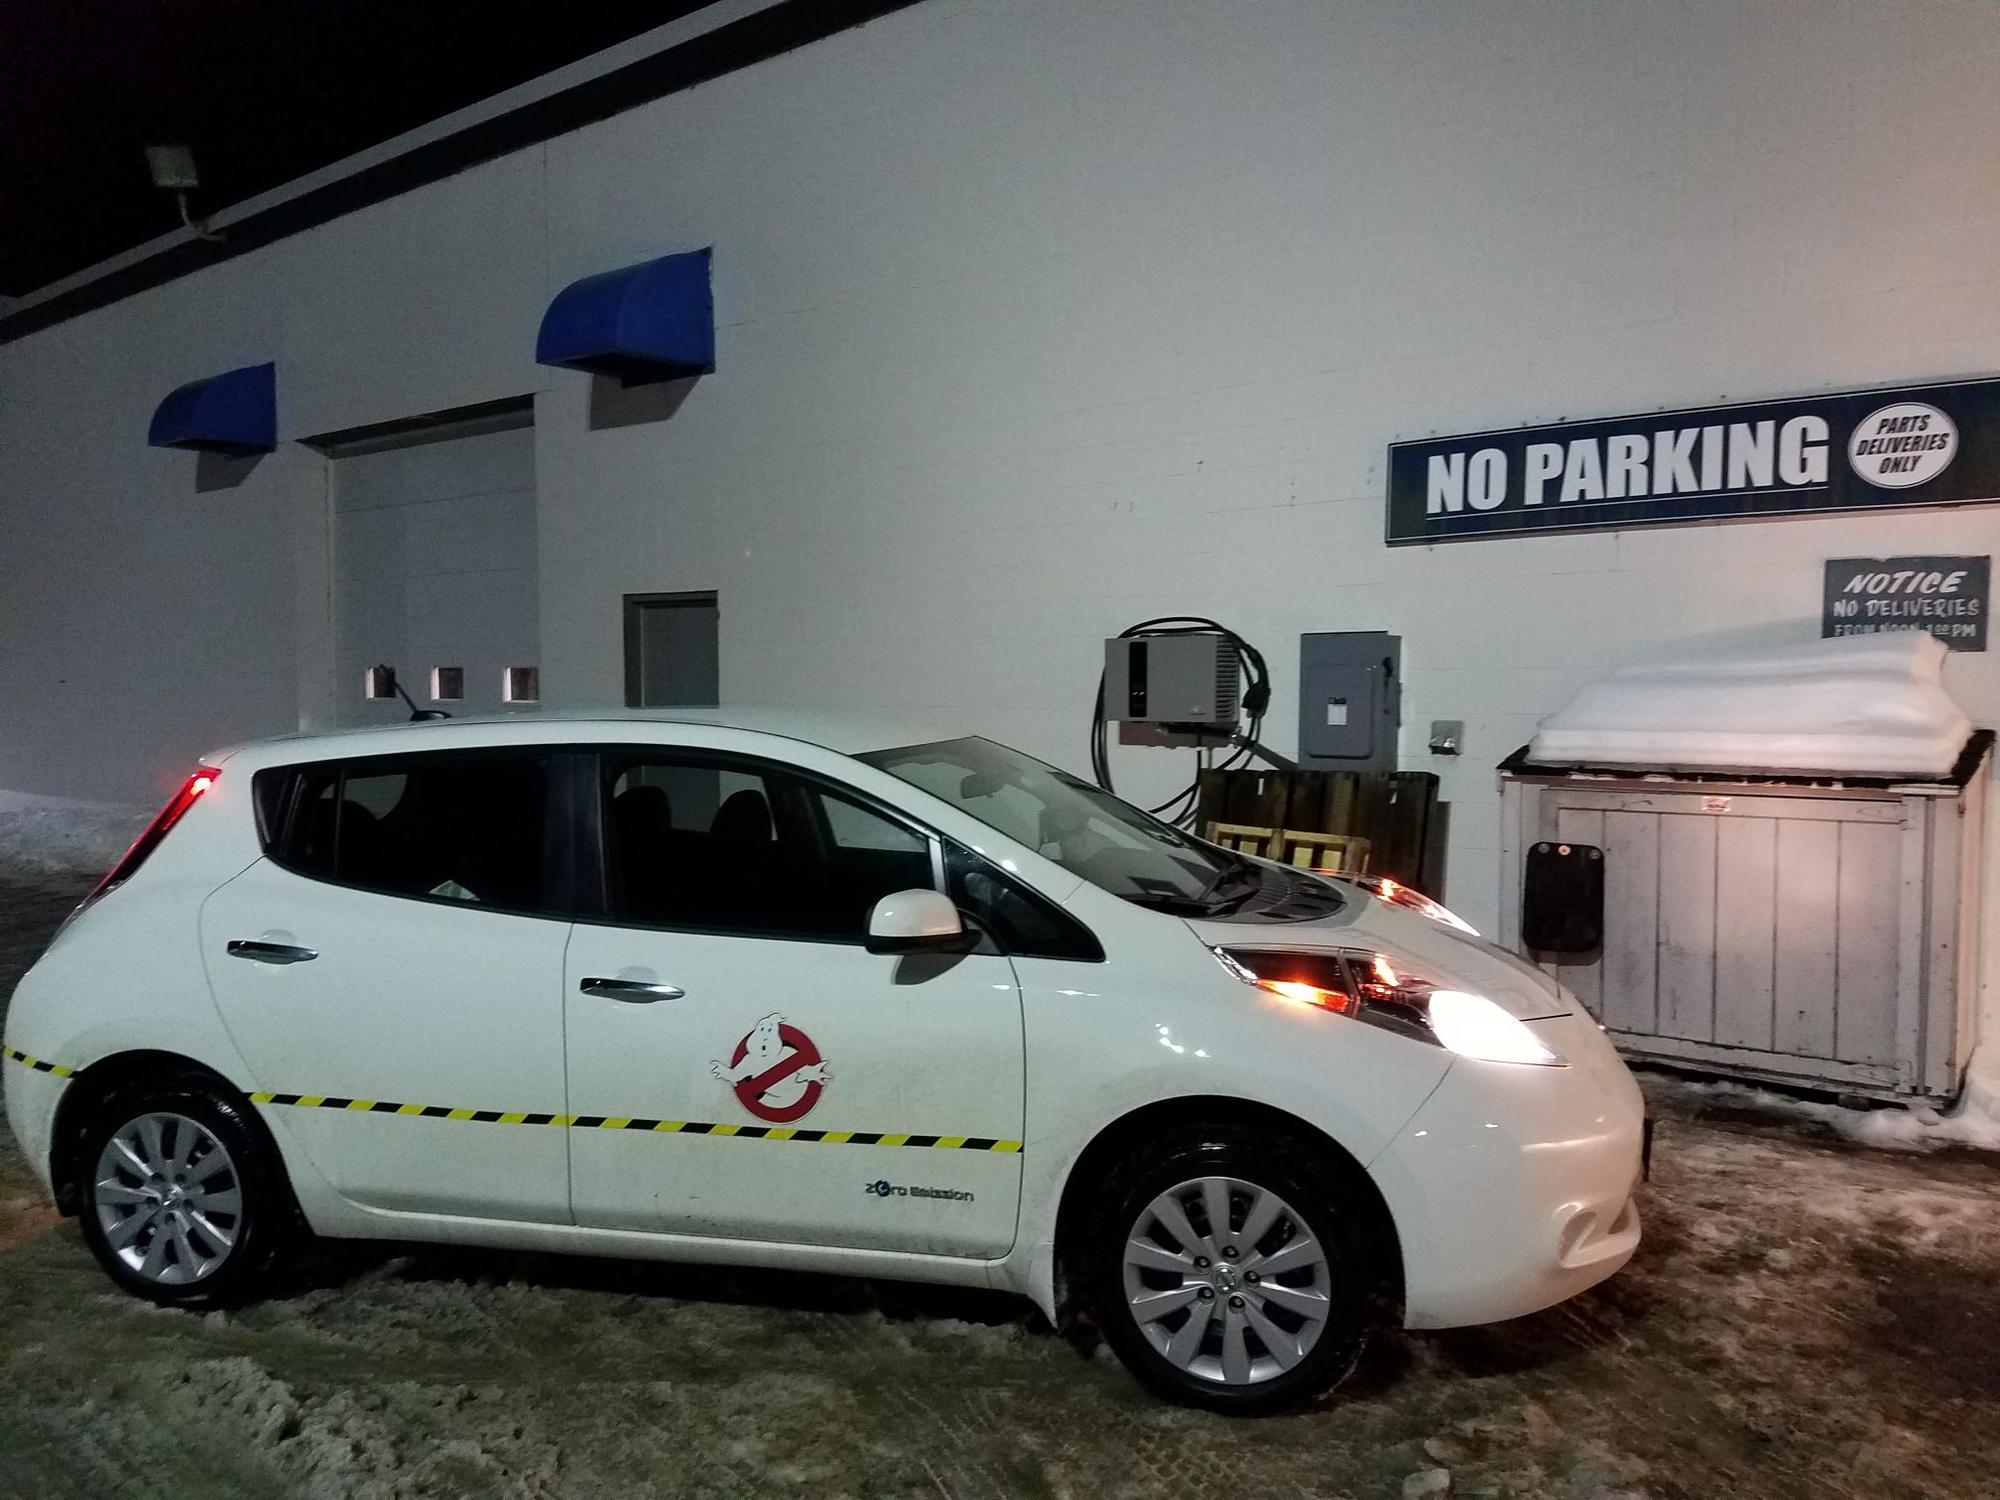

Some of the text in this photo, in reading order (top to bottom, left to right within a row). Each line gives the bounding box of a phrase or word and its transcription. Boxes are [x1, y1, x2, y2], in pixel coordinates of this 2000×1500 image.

[1877, 414, 1930, 435] PARTS
[1856, 433, 1950, 456] DELIVERIES
[1427, 415, 1829, 514] NO PARKING
[1879, 455, 1922, 474] ONLY
[1843, 571, 1968, 594] NOTICE
[1833, 598, 1980, 618] NO DELIVERIES
